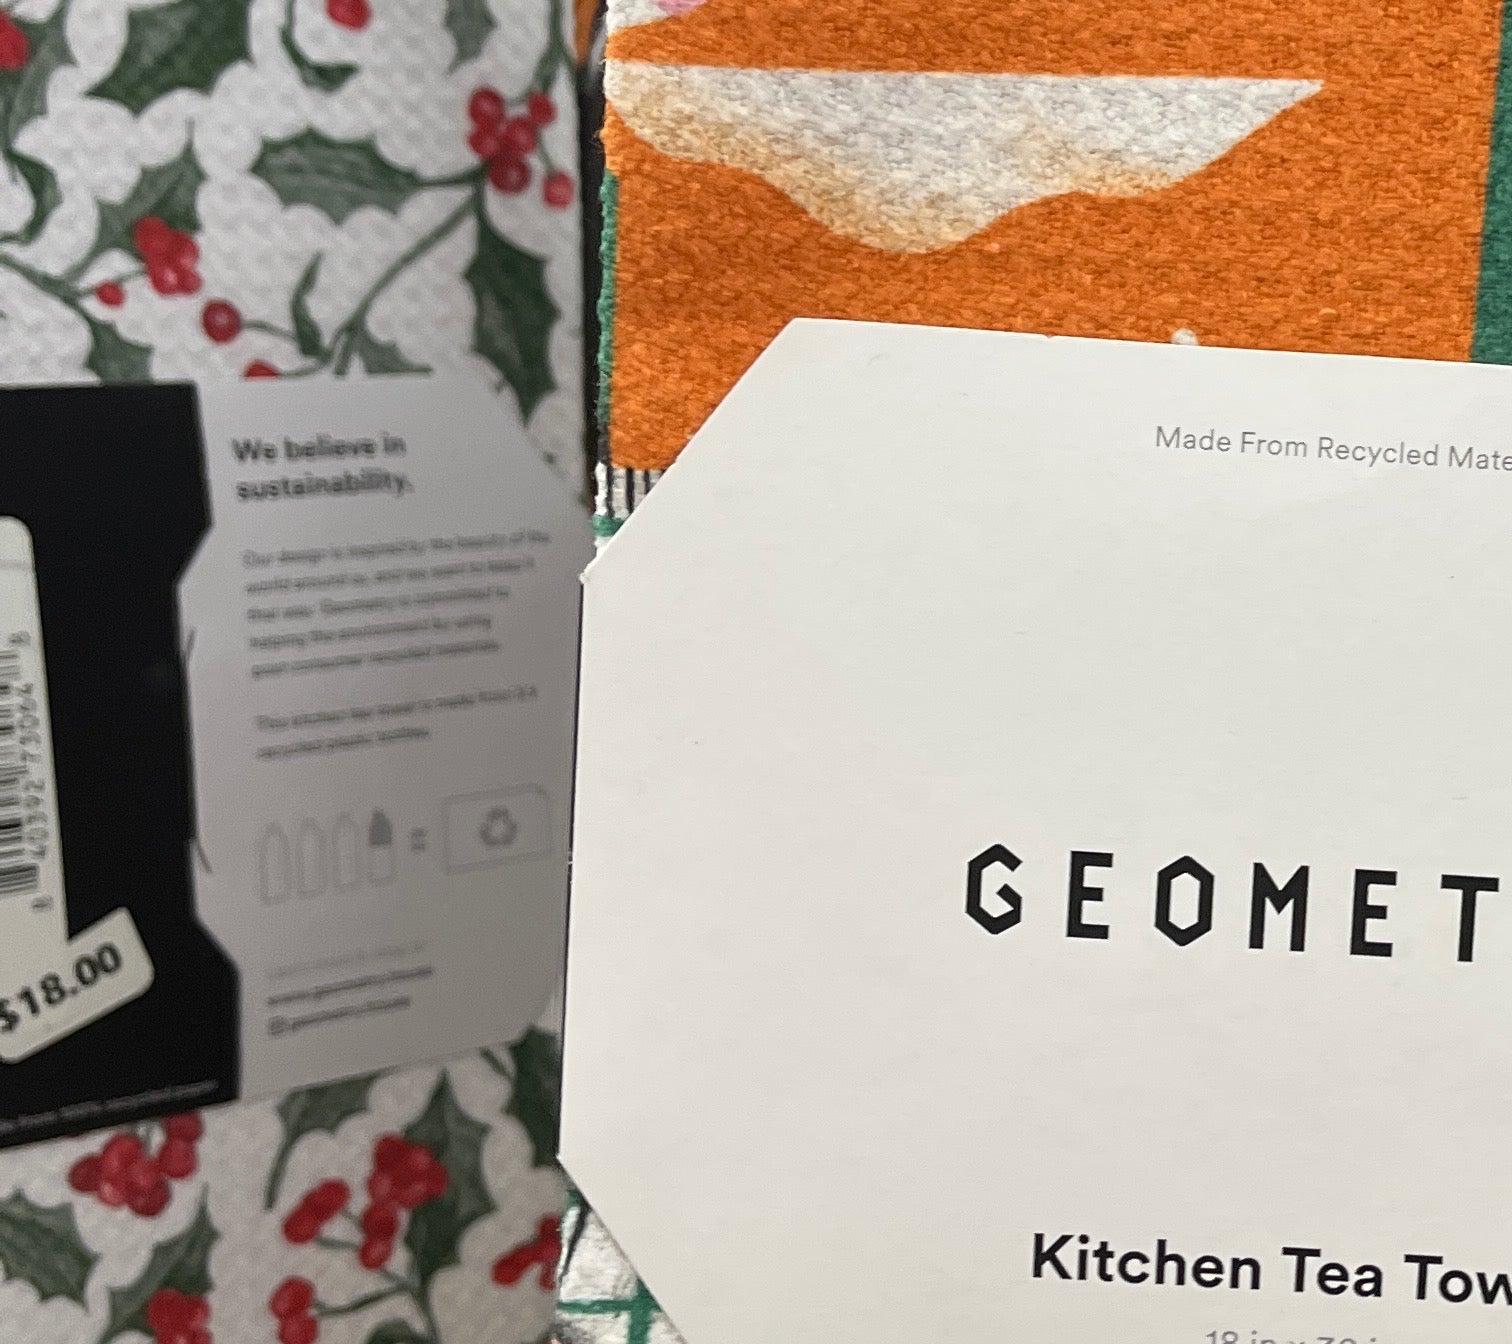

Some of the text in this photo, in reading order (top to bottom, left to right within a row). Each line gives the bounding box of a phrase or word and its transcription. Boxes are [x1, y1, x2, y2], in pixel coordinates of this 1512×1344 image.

[232, 431, 407, 462] We believe in
[1155, 425, 1232, 453] Made
[1240, 431, 1308, 457] From
[1317, 436, 1439, 468] Recycled
[235, 469, 415, 502] sustainability.
[0, 940, 122, 1034] $18.00
[1031, 1231, 1262, 1292] Kitchen
[1280, 1245, 1384, 1299] Tea
